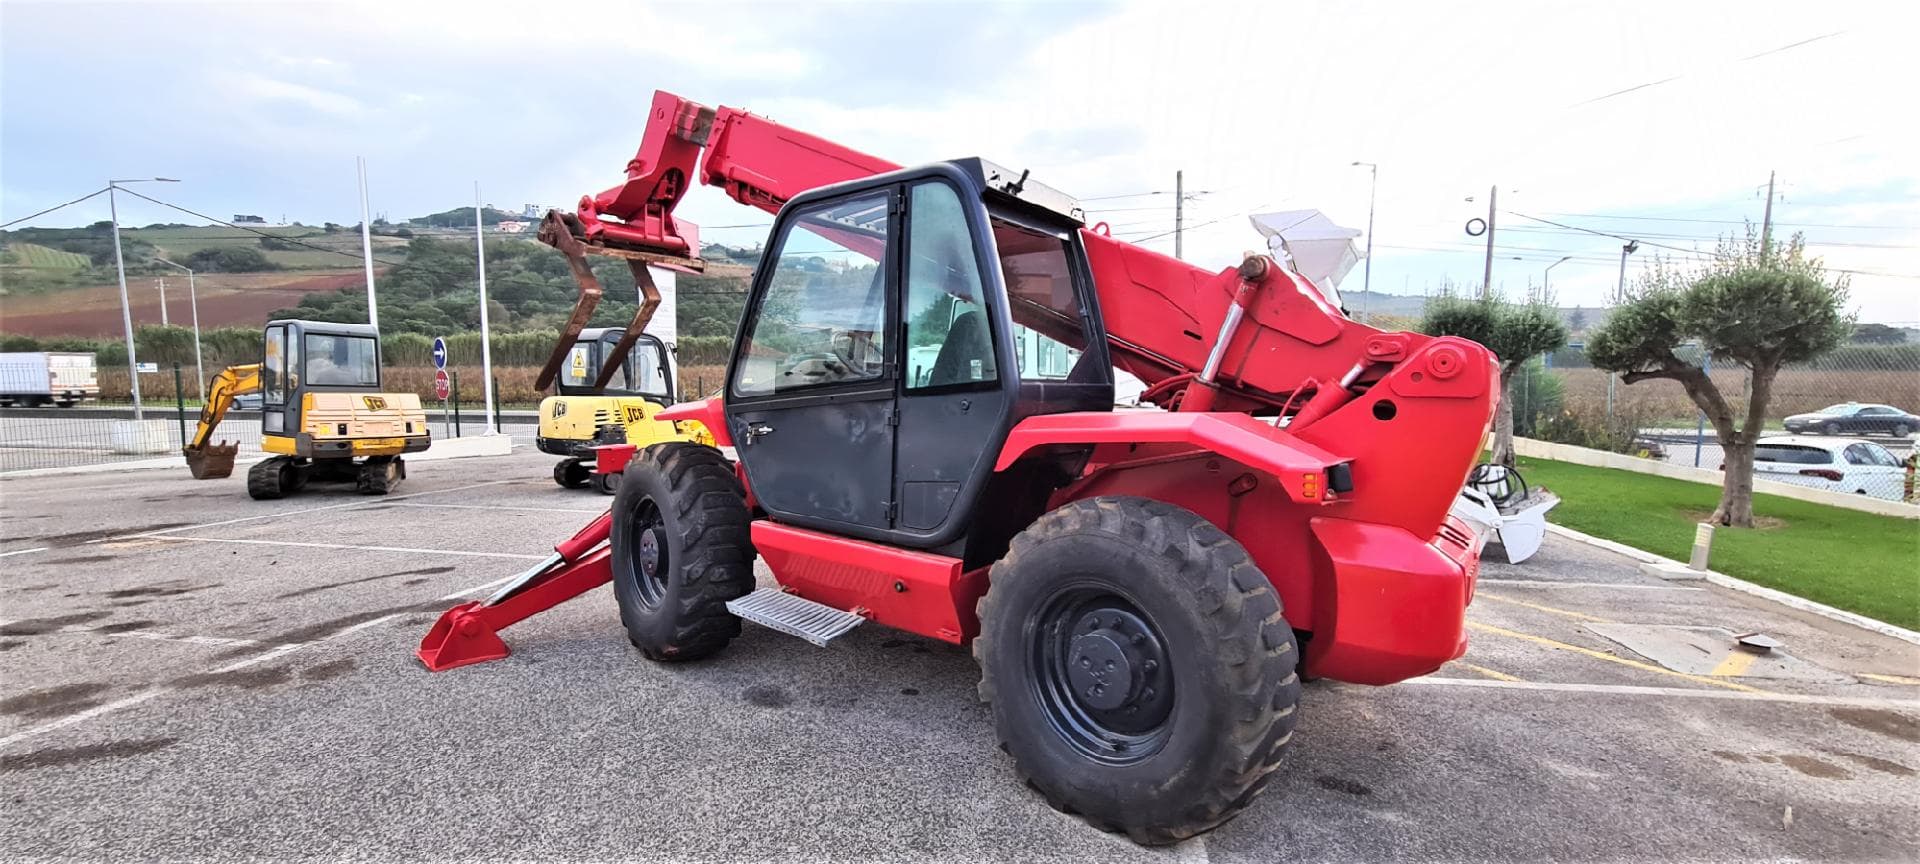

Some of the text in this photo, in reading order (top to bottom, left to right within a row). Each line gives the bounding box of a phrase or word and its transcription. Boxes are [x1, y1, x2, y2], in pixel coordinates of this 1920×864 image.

[436, 378, 448, 390] STOP
[552, 401, 567, 418] JCB
[627, 407, 644, 423] JCB
